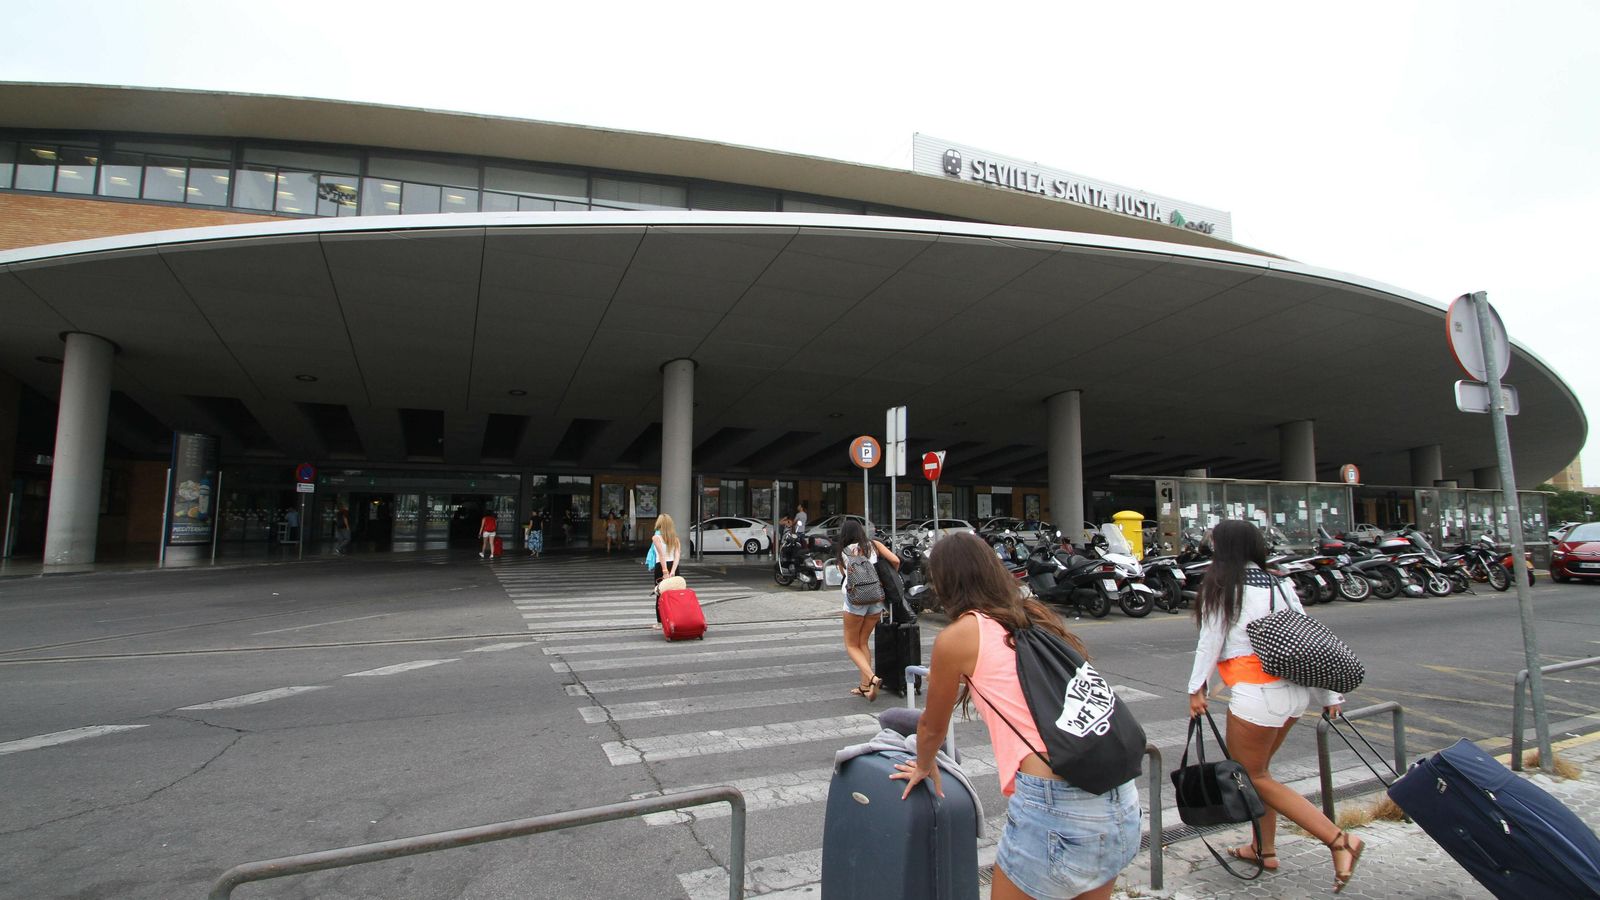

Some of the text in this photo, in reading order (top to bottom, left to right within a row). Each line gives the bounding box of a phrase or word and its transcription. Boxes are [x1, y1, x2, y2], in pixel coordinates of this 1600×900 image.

[971, 159, 1162, 222] SEVILLA SANTA JUSTA
[1067, 679, 1091, 702] VAS
